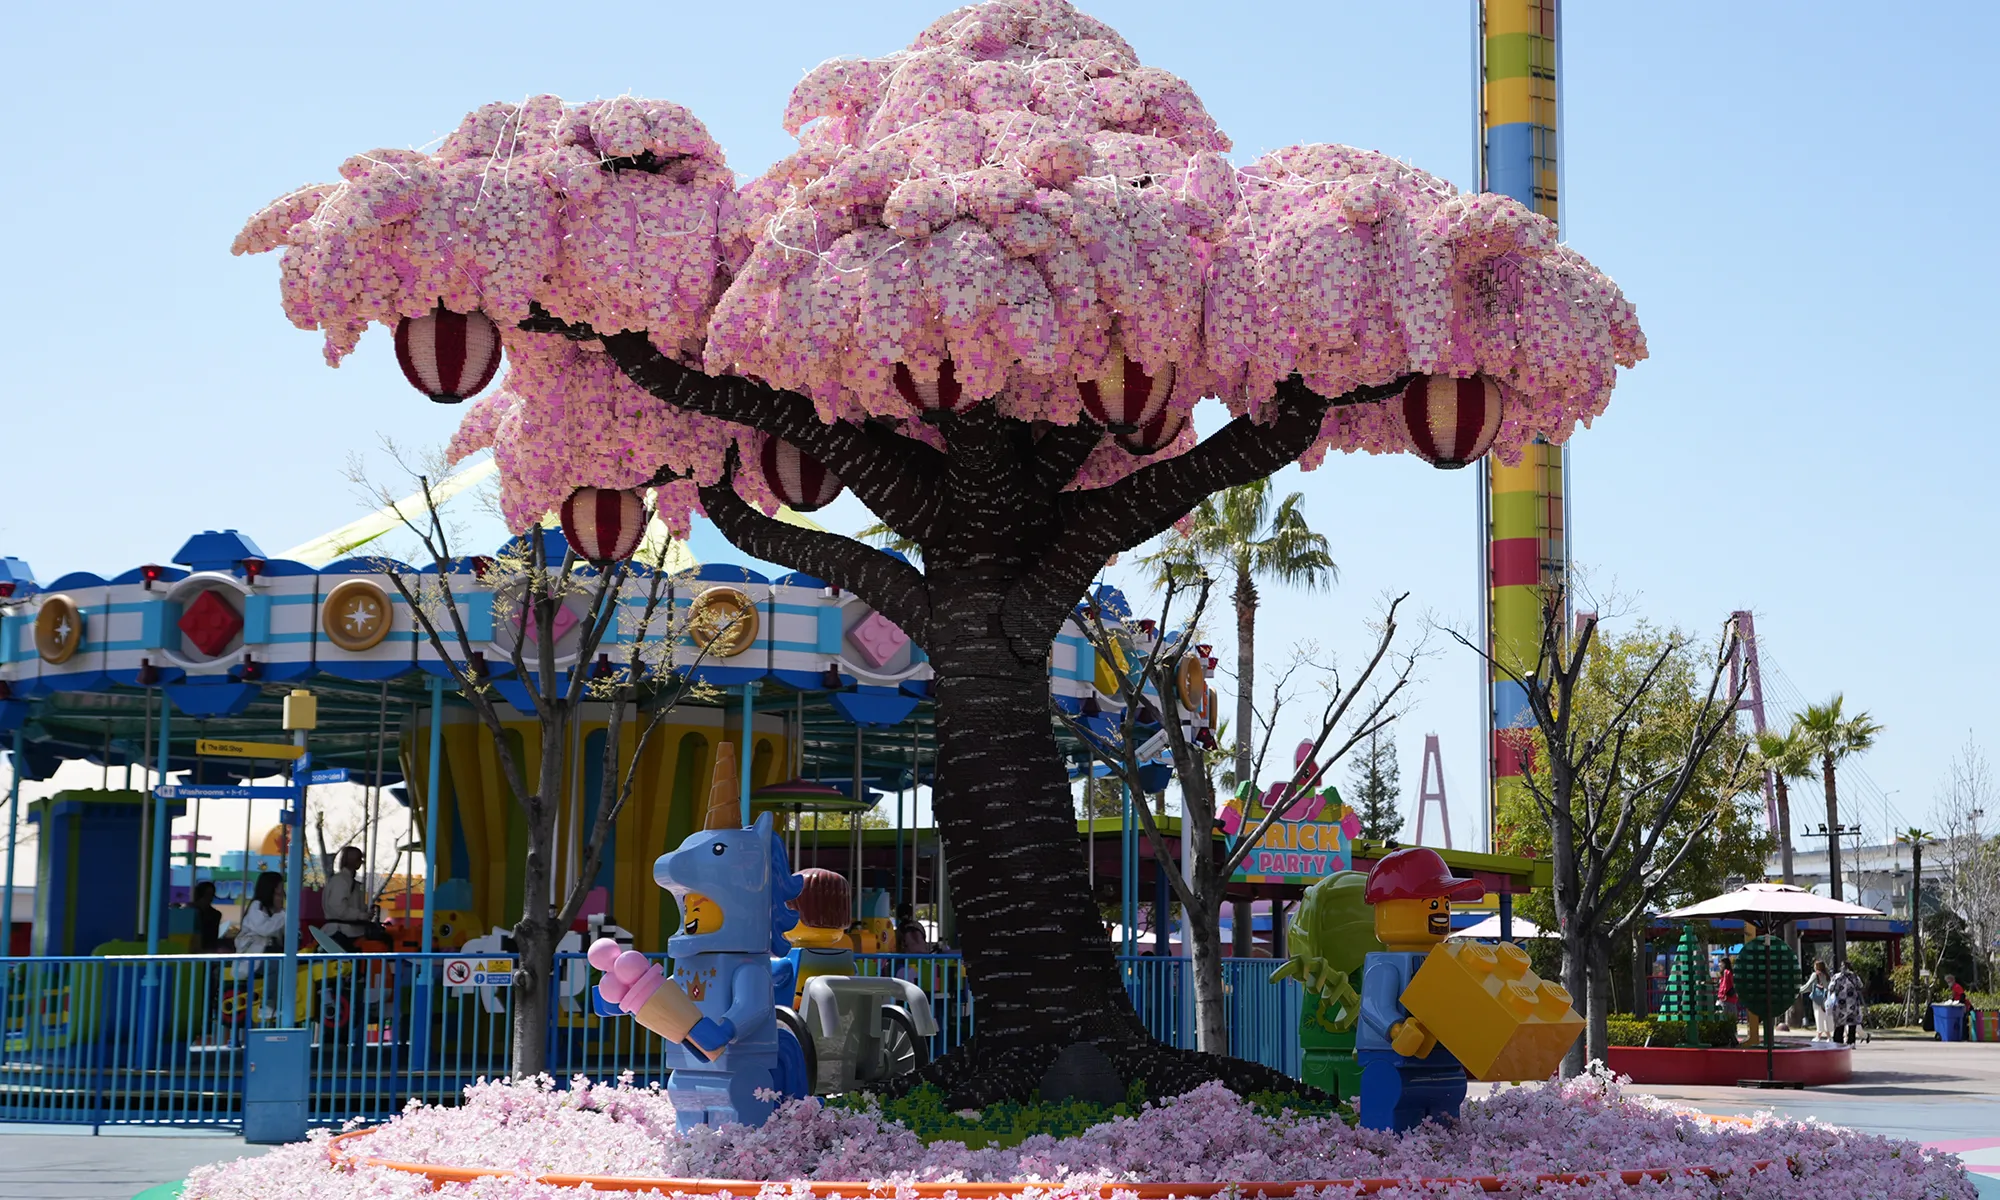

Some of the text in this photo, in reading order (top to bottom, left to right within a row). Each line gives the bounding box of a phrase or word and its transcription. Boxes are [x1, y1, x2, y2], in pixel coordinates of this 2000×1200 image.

[229, 745, 243, 753] Shop
[178, 787, 224, 796] Washrooms
[1258, 852, 1327, 874] PARTY
